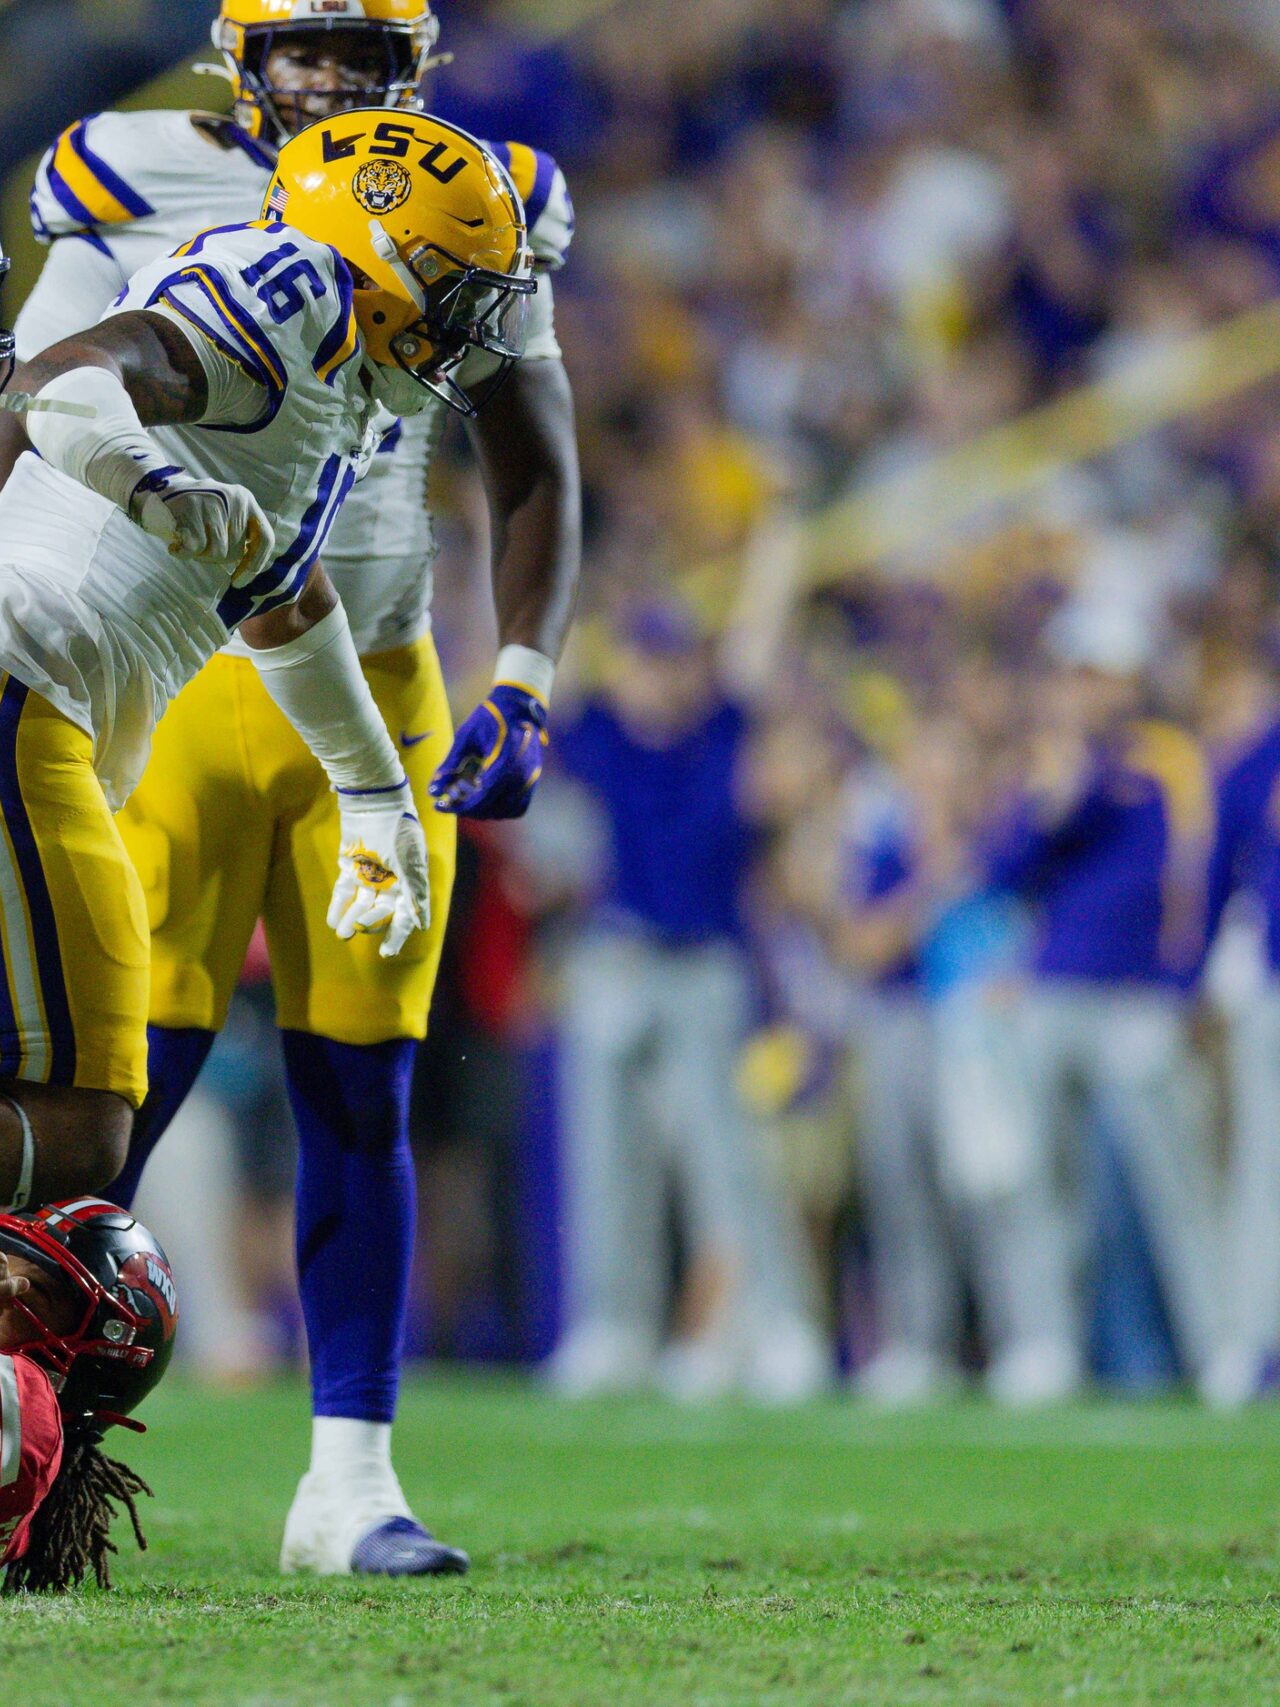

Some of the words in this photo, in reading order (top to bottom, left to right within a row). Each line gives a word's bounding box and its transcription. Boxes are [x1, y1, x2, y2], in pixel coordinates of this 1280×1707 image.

[321, 122, 469, 185] LSU
[239, 241, 328, 325] 16
[145, 1259, 177, 1317] WKU
